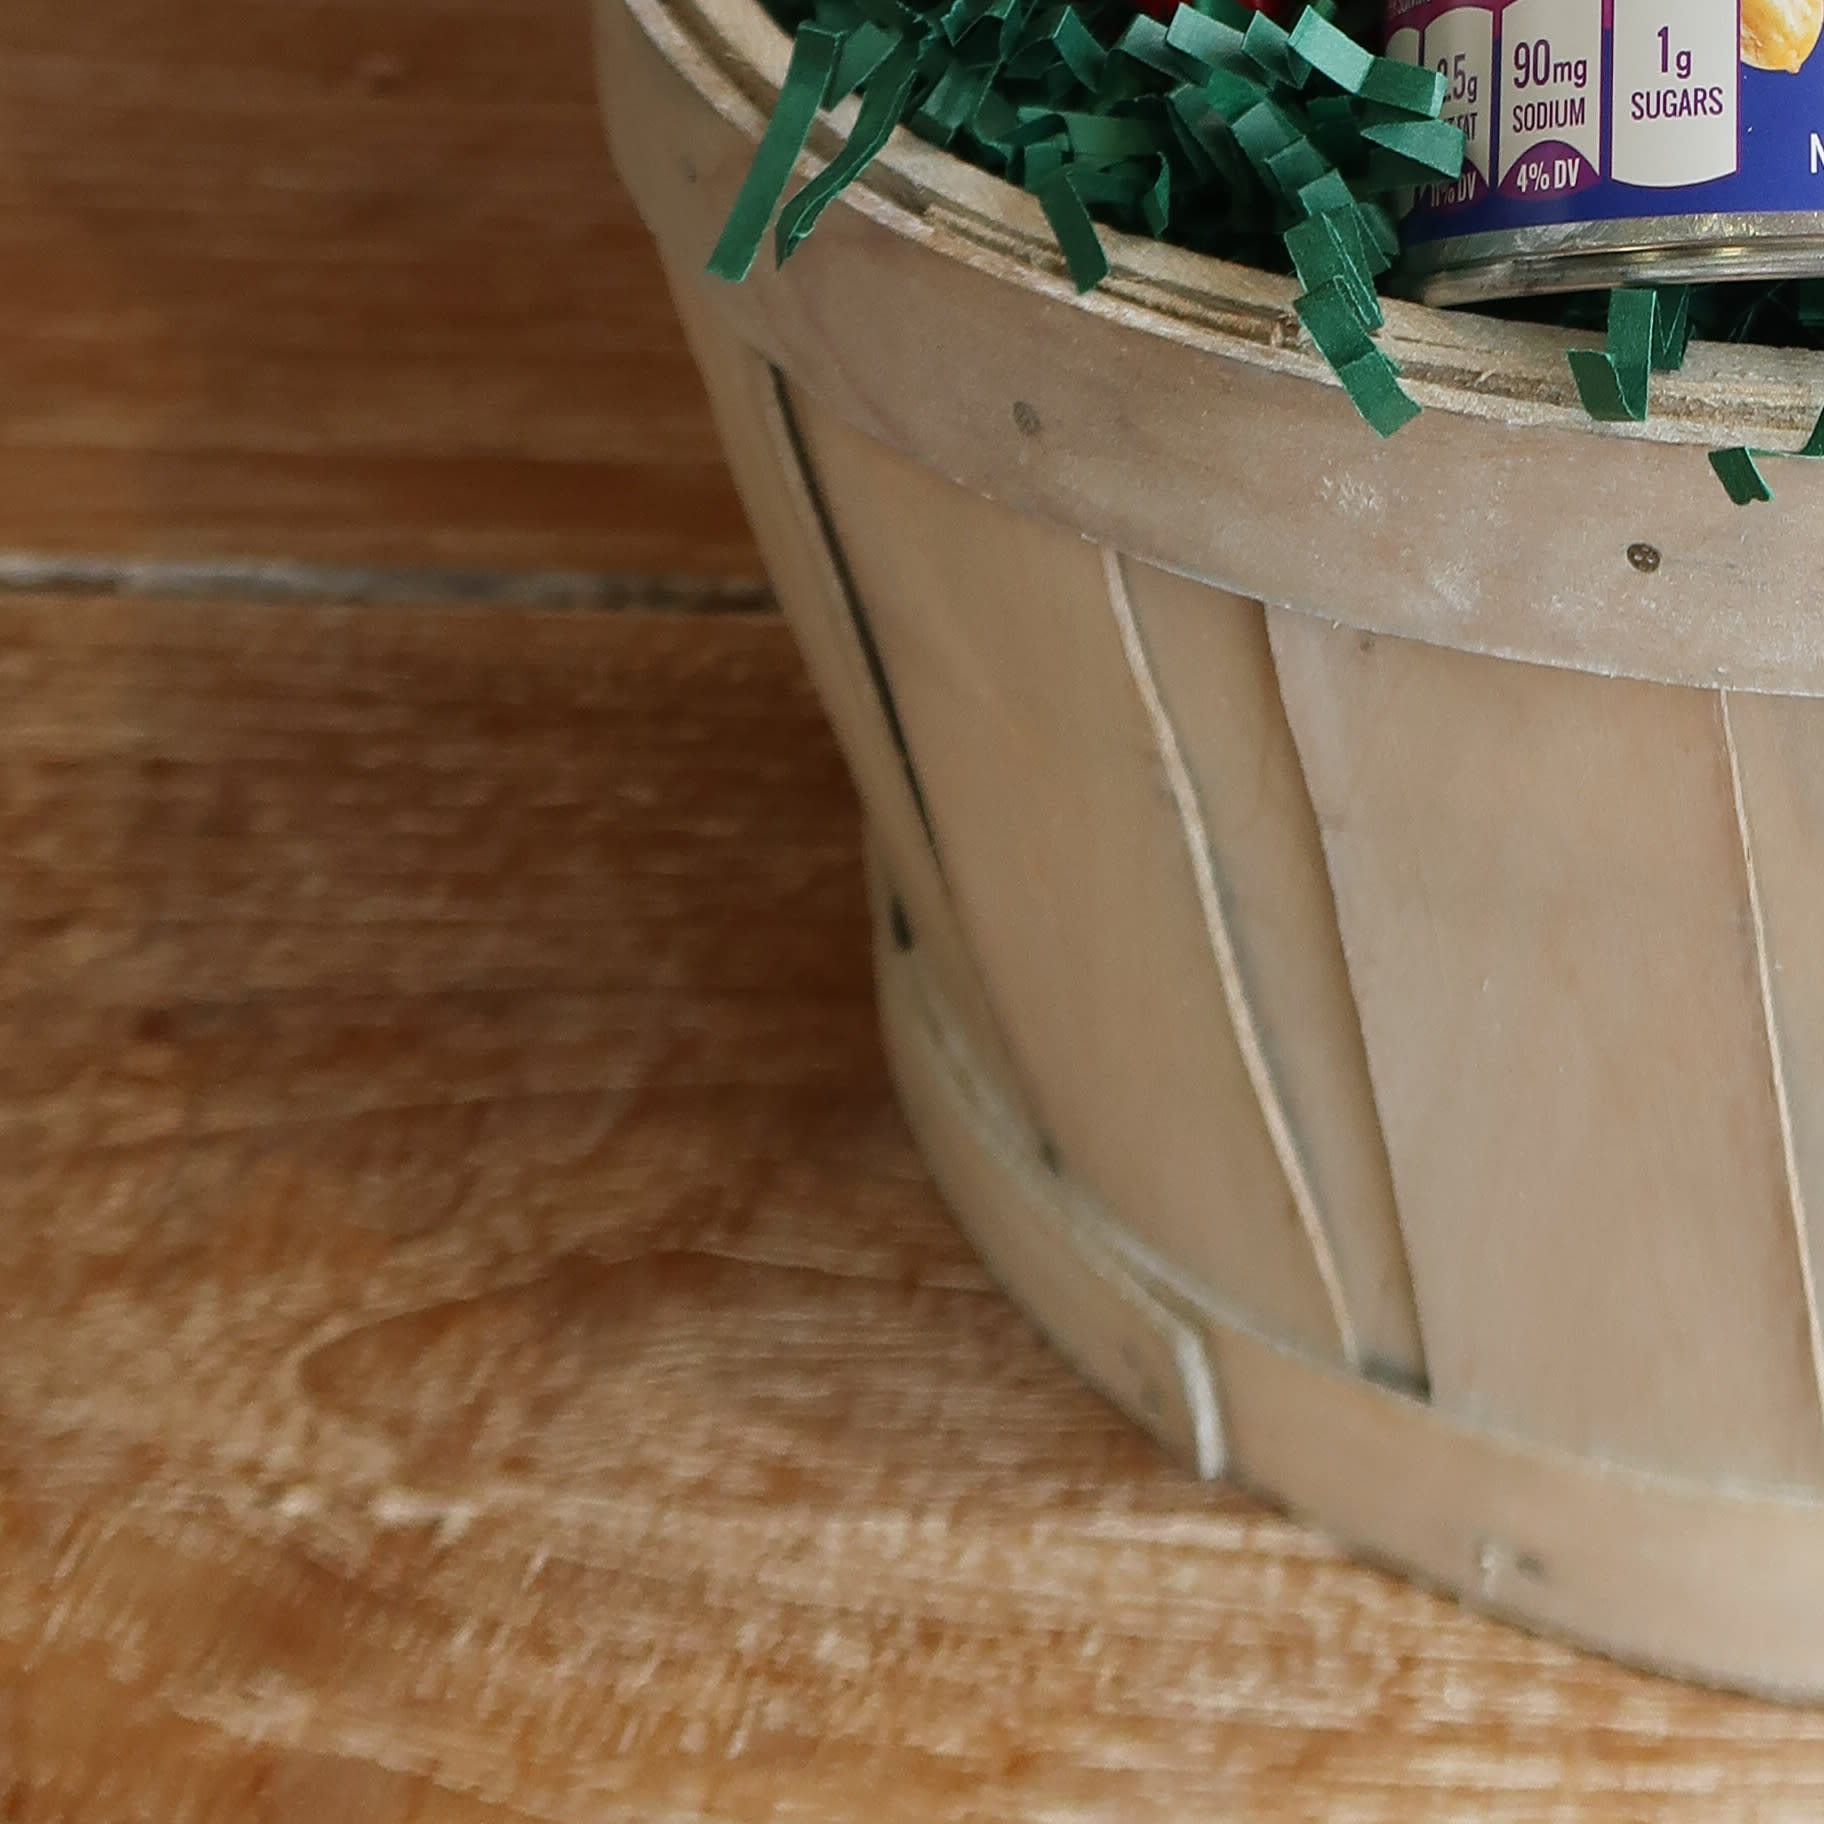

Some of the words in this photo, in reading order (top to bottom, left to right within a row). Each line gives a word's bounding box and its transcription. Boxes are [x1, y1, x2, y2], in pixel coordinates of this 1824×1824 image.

[1512, 96, 1586, 134] SODIUM
[1630, 86, 1724, 122] SUGARS
[1516, 160, 1550, 194] 4%
[1553, 157, 1580, 190] DV
